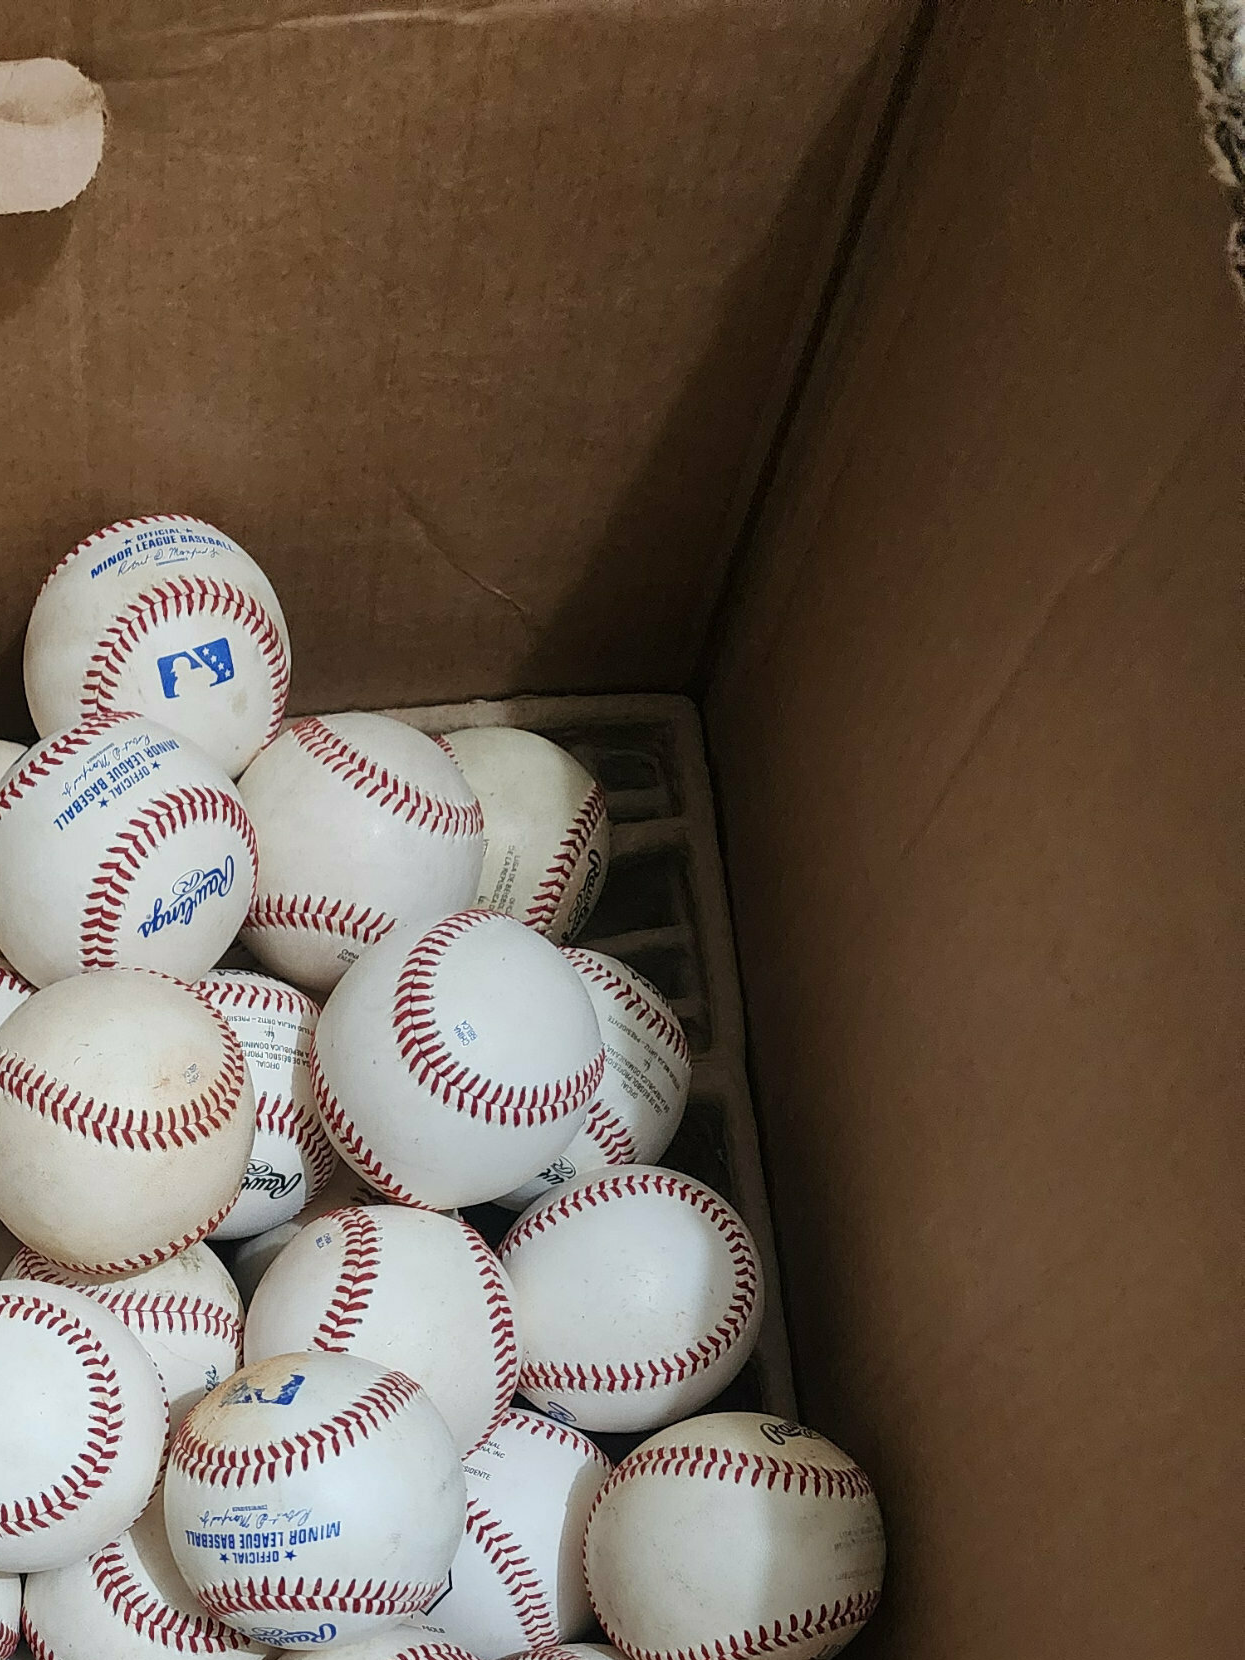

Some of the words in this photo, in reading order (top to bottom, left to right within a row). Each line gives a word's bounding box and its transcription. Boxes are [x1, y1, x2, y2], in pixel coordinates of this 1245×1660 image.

[136, 528, 181, 541] OFFICIAL
[90, 547, 133, 579] MINOR
[136, 538, 177, 553] LEAGUE
[180, 535, 235, 553] BASEBALL
[151, 738, 180, 766] MINOR
[105, 752, 147, 784] LEAGUE
[107, 767, 151, 800] OFFICIAL
[52, 776, 110, 832] BASEBALL
[136, 855, 235, 938] Rawlings
[257, 1016, 276, 1025] ORTIZ
[454, 1024, 470, 1046] CHINA
[256, 1060, 281, 1070] OFICIAL
[463, 1465, 492, 1481] SIDENTE
[185, 1530, 235, 1549] BASEBALL
[239, 1531, 284, 1549] LEAGUE
[289, 1521, 341, 1546] MINOR
[232, 1551, 280, 1564] OFFICIAL
